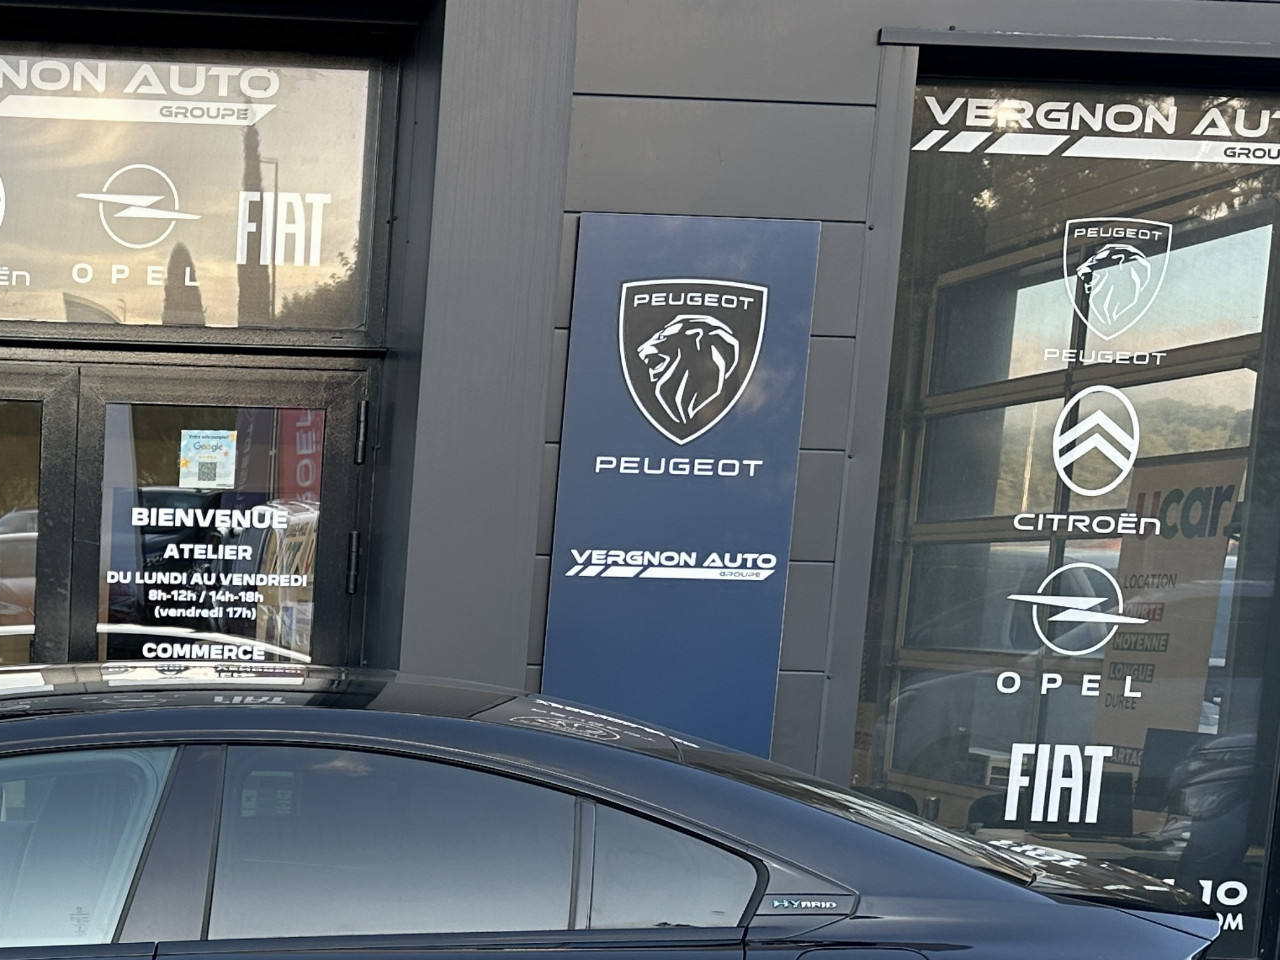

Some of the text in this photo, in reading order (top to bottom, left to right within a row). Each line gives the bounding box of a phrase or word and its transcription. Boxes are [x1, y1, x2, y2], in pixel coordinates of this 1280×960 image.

[123, 63, 281, 99] AUTO
[159, 105, 250, 121] GROUPE
[924, 96, 1178, 135] VERGNON
[237, 192, 332, 267] FIAT
[1074, 227, 1163, 241] PEUGEOT
[72, 263, 200, 287] OPEL
[633, 292, 755, 310] PEUGEOT
[1043, 348, 1167, 366] PEUGEOT
[193, 442, 223, 452] Google
[595, 457, 763, 477] PEUGEOT
[131, 507, 289, 529] BIENVENUE
[1013, 513, 1161, 535] CITROËN
[163, 544, 253, 560] ATELIER
[570, 549, 777, 569] VERGNON AUTO
[106, 571, 308, 587] DU LUNDI AU VENDREDI
[719, 571, 761, 579] GROUPE
[1123, 573, 1178, 589] LOCATION
[148, 590, 197, 602] 8h-12h
[209, 591, 264, 603] 14h-18h
[154, 606, 257, 620] (vendredi 17h)
[1114, 634, 1168, 650] MOYENNE
[142, 643, 266, 660] COMMERCE
[1109, 664, 1153, 681] LONGUE
[997, 671, 1142, 698] OPEL
[1004, 743, 1113, 824] FIAT
[773, 899, 837, 909] HYBRID
